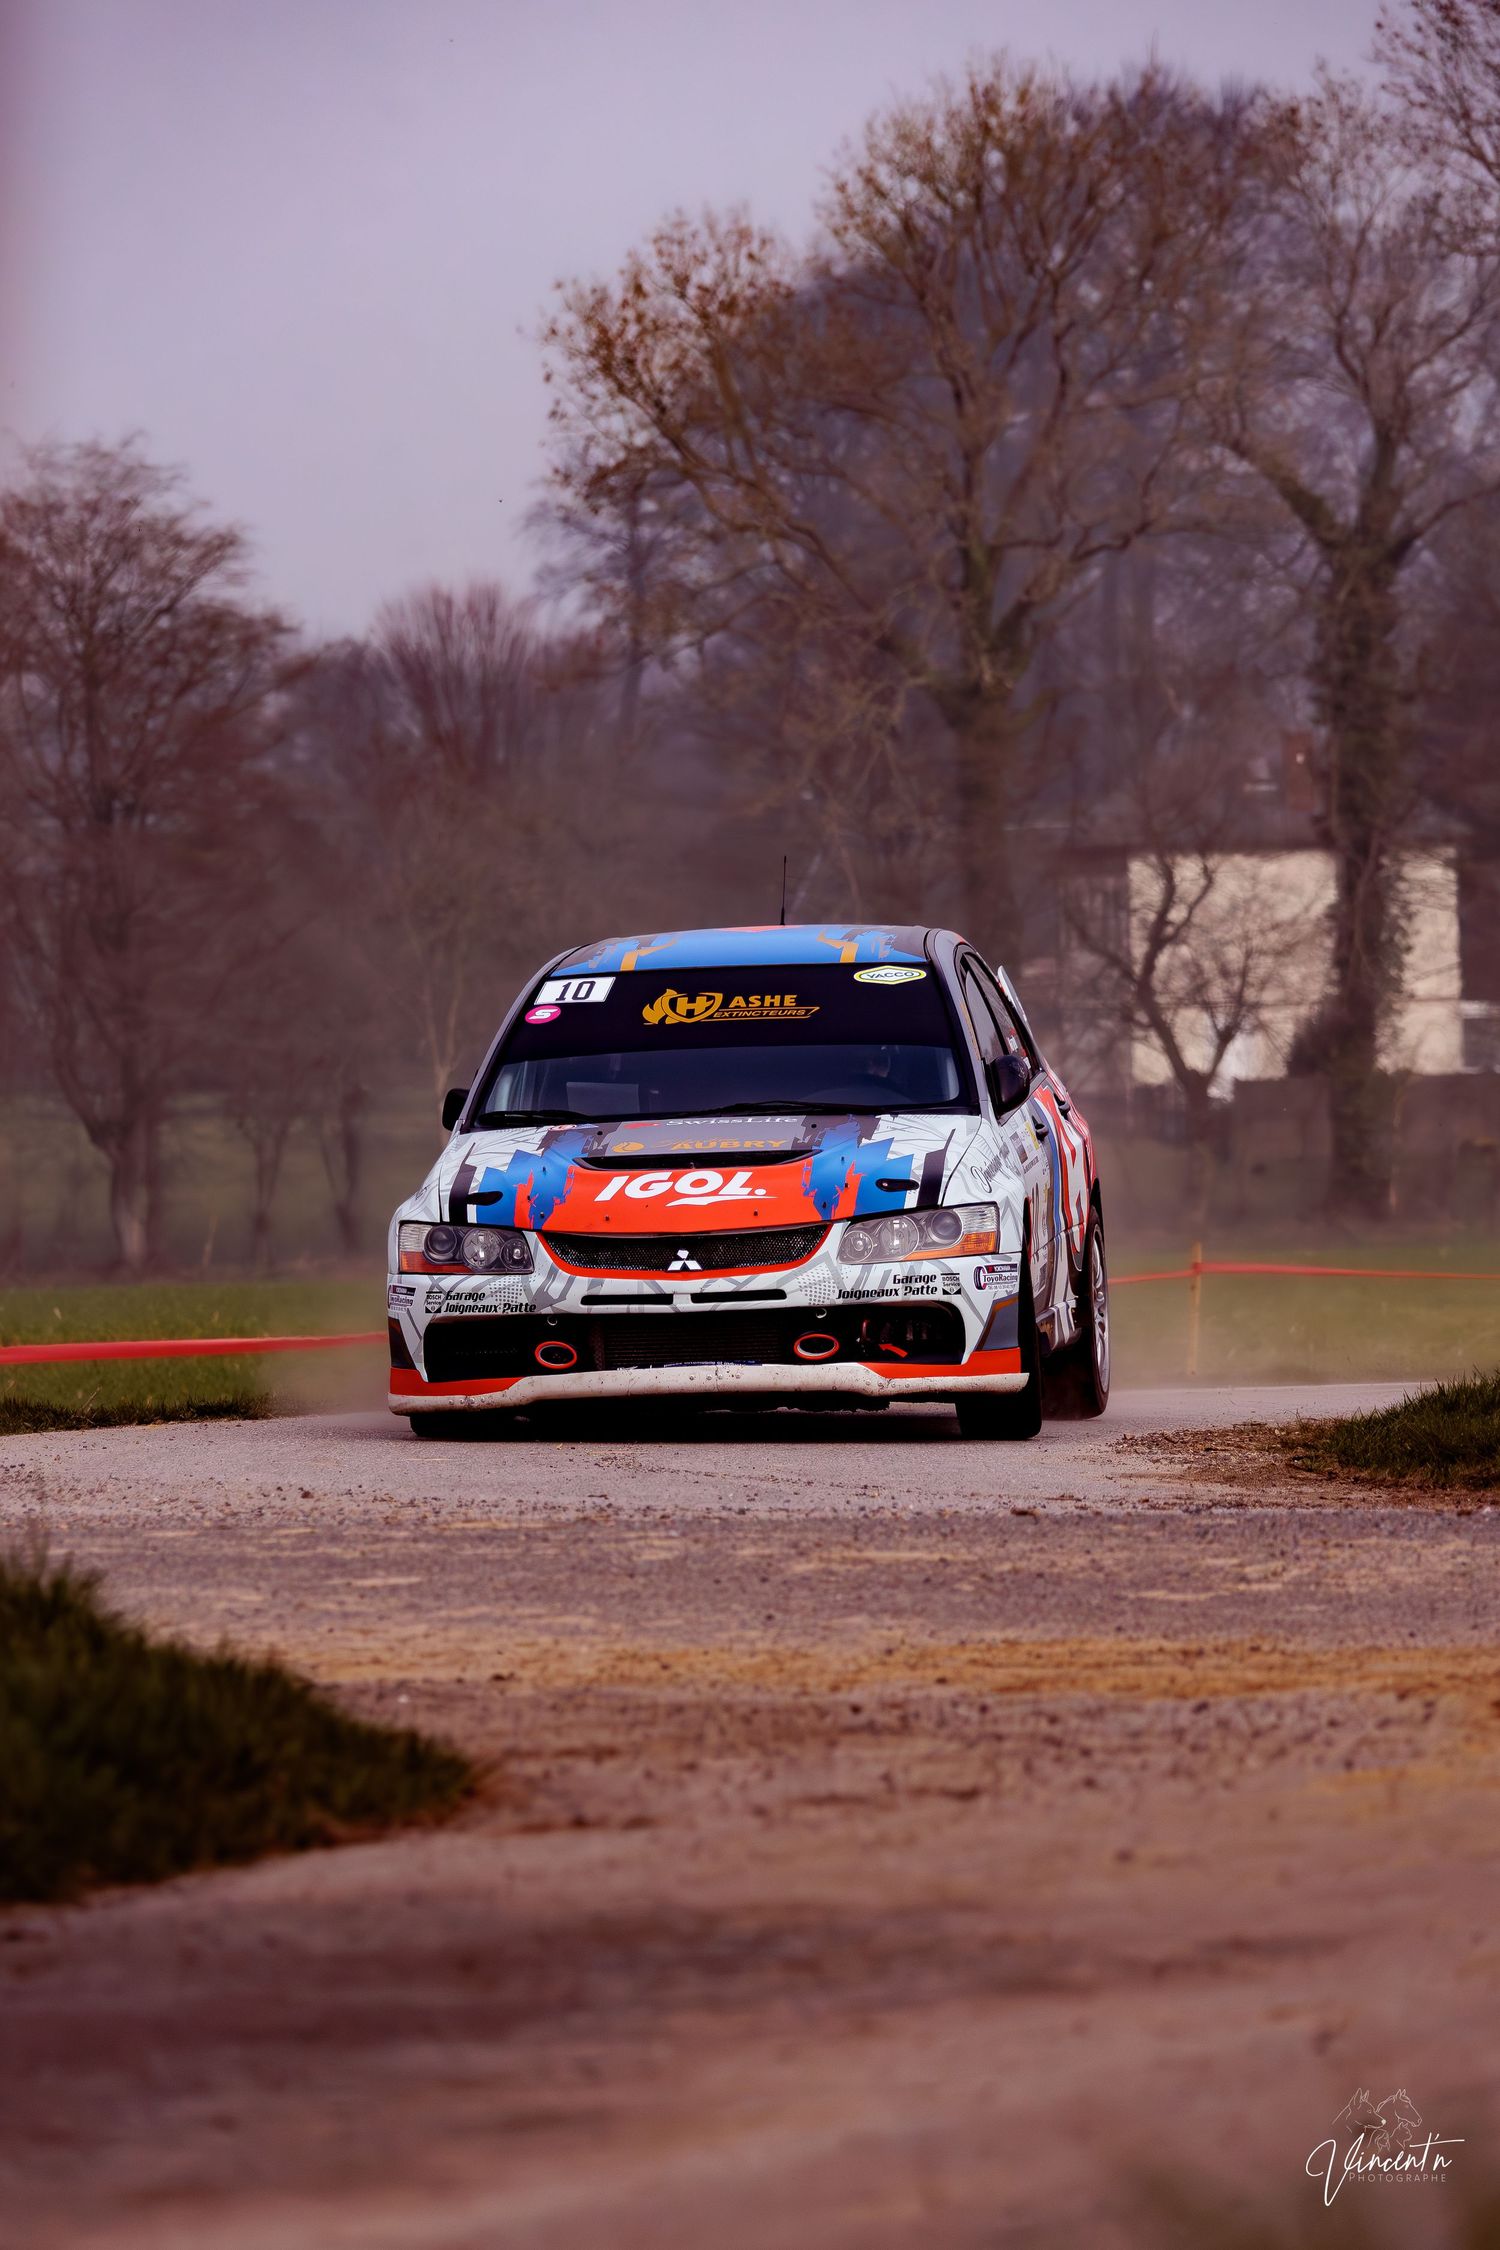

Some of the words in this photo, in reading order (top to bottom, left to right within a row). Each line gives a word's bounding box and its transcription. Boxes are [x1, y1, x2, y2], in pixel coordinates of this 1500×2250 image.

[554, 980, 597, 1002] 10
[728, 994, 798, 1008] ASHE
[713, 1009, 806, 1018] EXTINCTEURS
[670, 1140, 788, 1151] AUBRY
[893, 1273, 937, 1285] Garage
[445, 1291, 486, 1302] Garage
[836, 1287, 899, 1300] Joigneaux
[904, 1284, 938, 1296] Patte
[444, 1303, 499, 1314] Joigneaux
[502, 1303, 537, 1313] Patte
